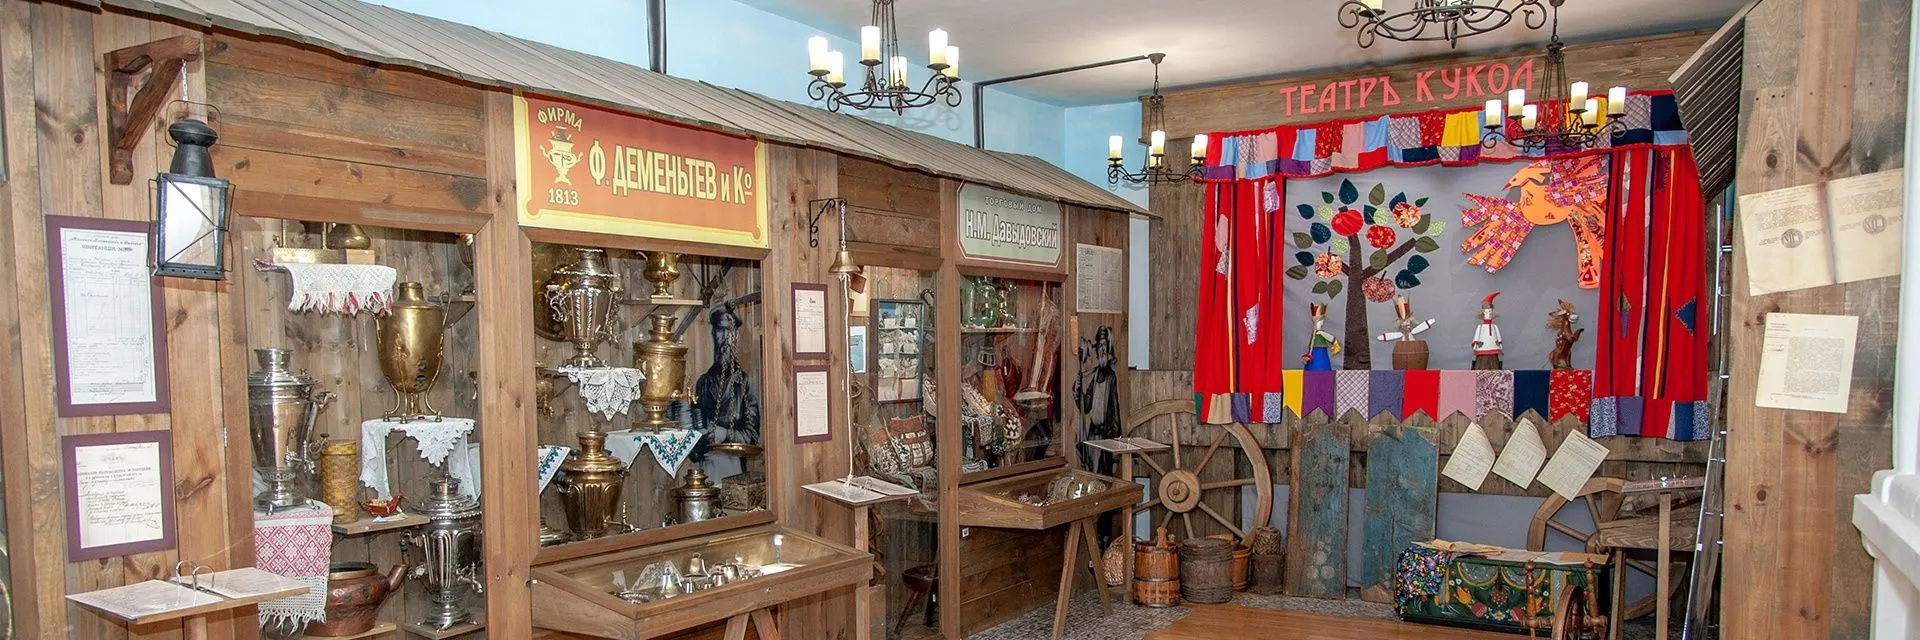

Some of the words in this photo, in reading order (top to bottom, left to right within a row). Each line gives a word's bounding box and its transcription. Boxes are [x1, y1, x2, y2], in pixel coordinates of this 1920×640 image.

[1280, 76, 1400, 116] ТЕАТРЪ
[1416, 59, 1533, 102] КУКОЛ
[537, 107, 583, 132] ФИРМА
[588, 139, 610, 186] Ф.
[612, 144, 718, 200] ДЕМЕНЬТЕВ
[548, 188, 579, 206] 1813
[985, 196, 1024, 211] ТОРГОВЫЙ
[1028, 203, 1042, 214] ДОМ
[965, 209, 991, 240] Н.М.
[992, 213, 1057, 249] Давыдовский
